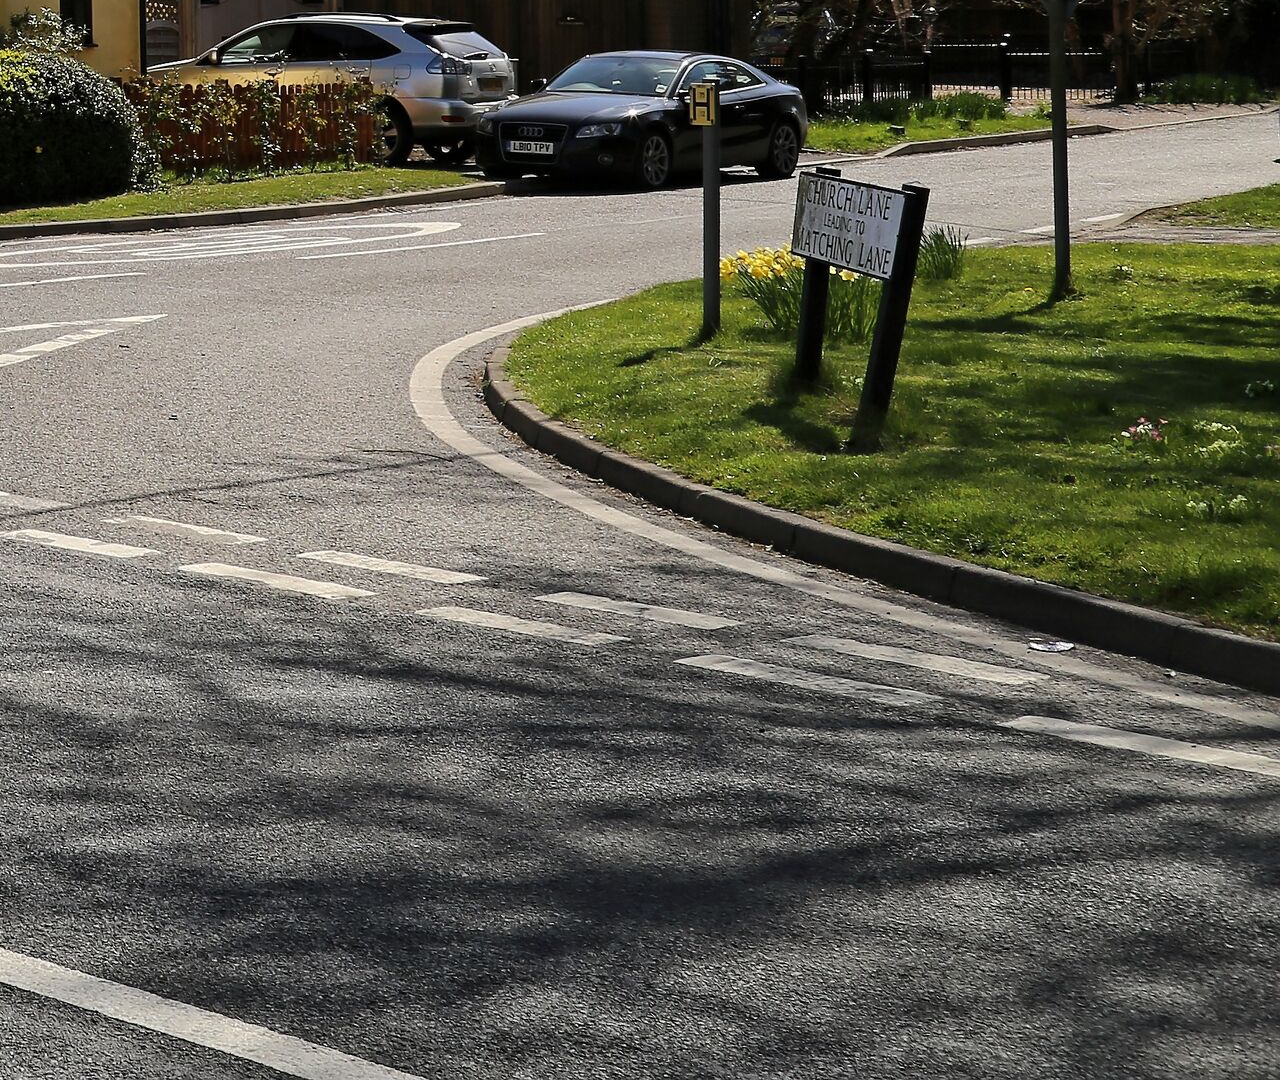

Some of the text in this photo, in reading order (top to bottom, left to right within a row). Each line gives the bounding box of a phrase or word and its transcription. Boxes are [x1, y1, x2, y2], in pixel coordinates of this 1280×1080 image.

[806, 180, 892, 220] CHURCH LANE
[823, 212, 865, 235] LEADING TO
[858, 242, 892, 275] LANE
